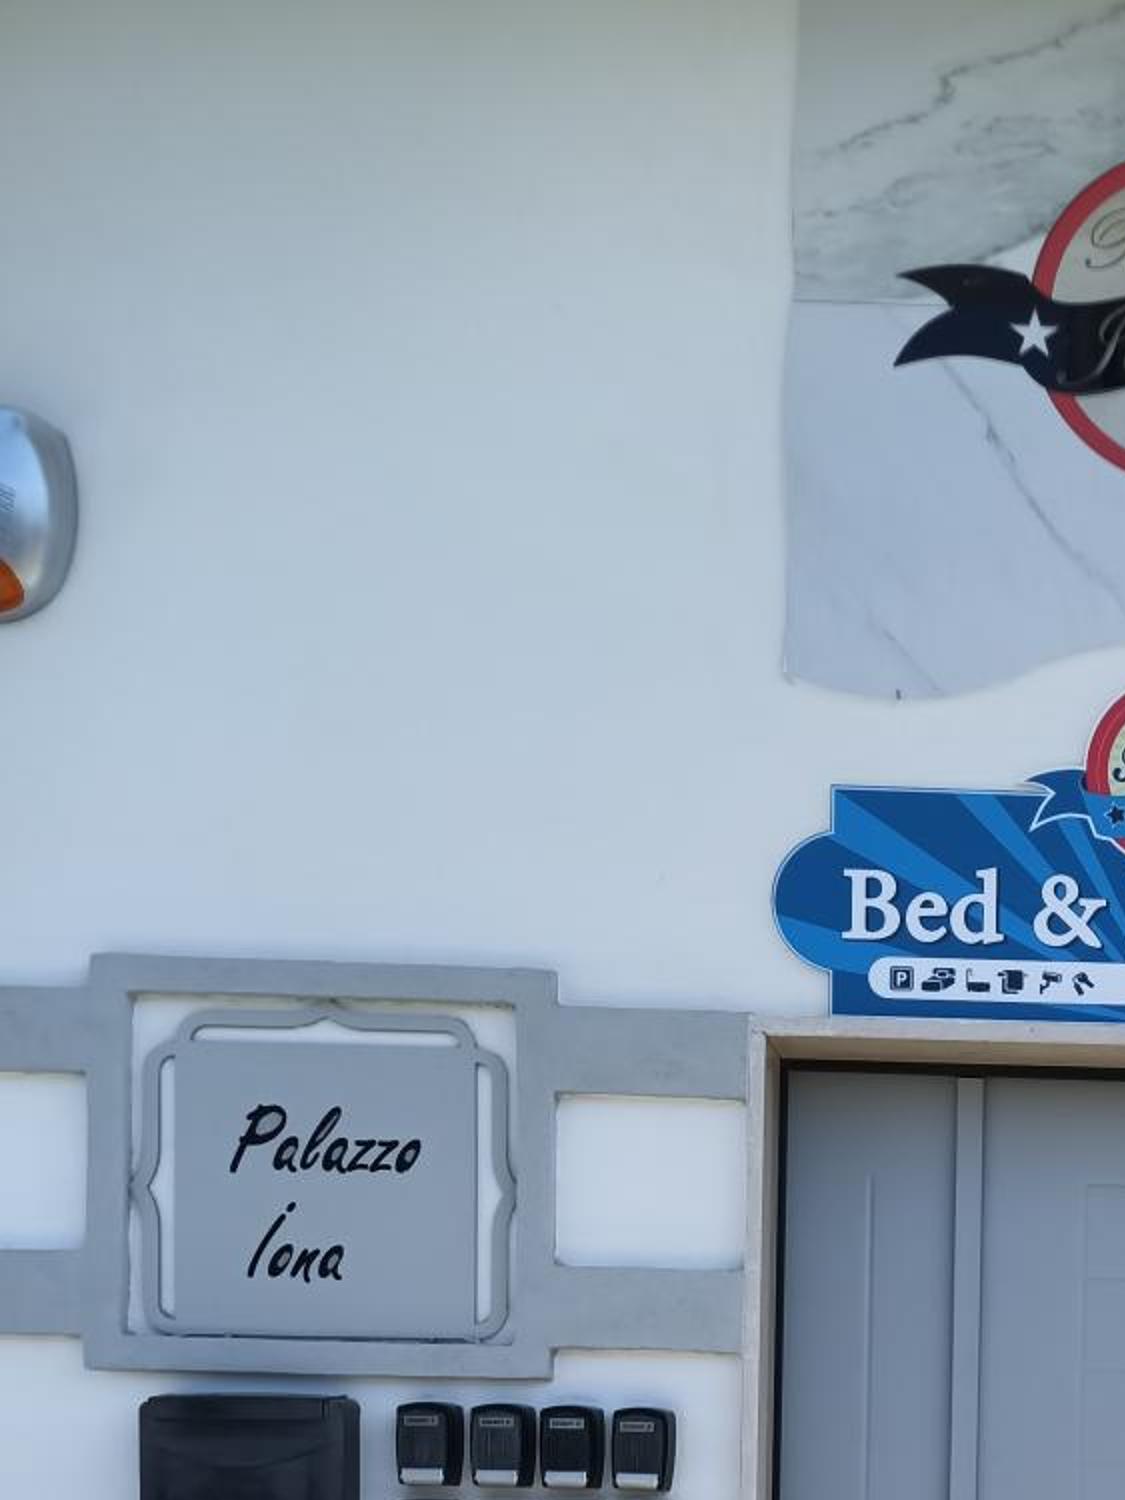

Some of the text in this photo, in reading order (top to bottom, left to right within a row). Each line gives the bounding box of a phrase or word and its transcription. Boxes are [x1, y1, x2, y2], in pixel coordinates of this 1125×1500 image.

[841, 867, 1005, 945] Bed
[1033, 873, 1107, 949] &
[229, 1104, 422, 1174] Palazzo
